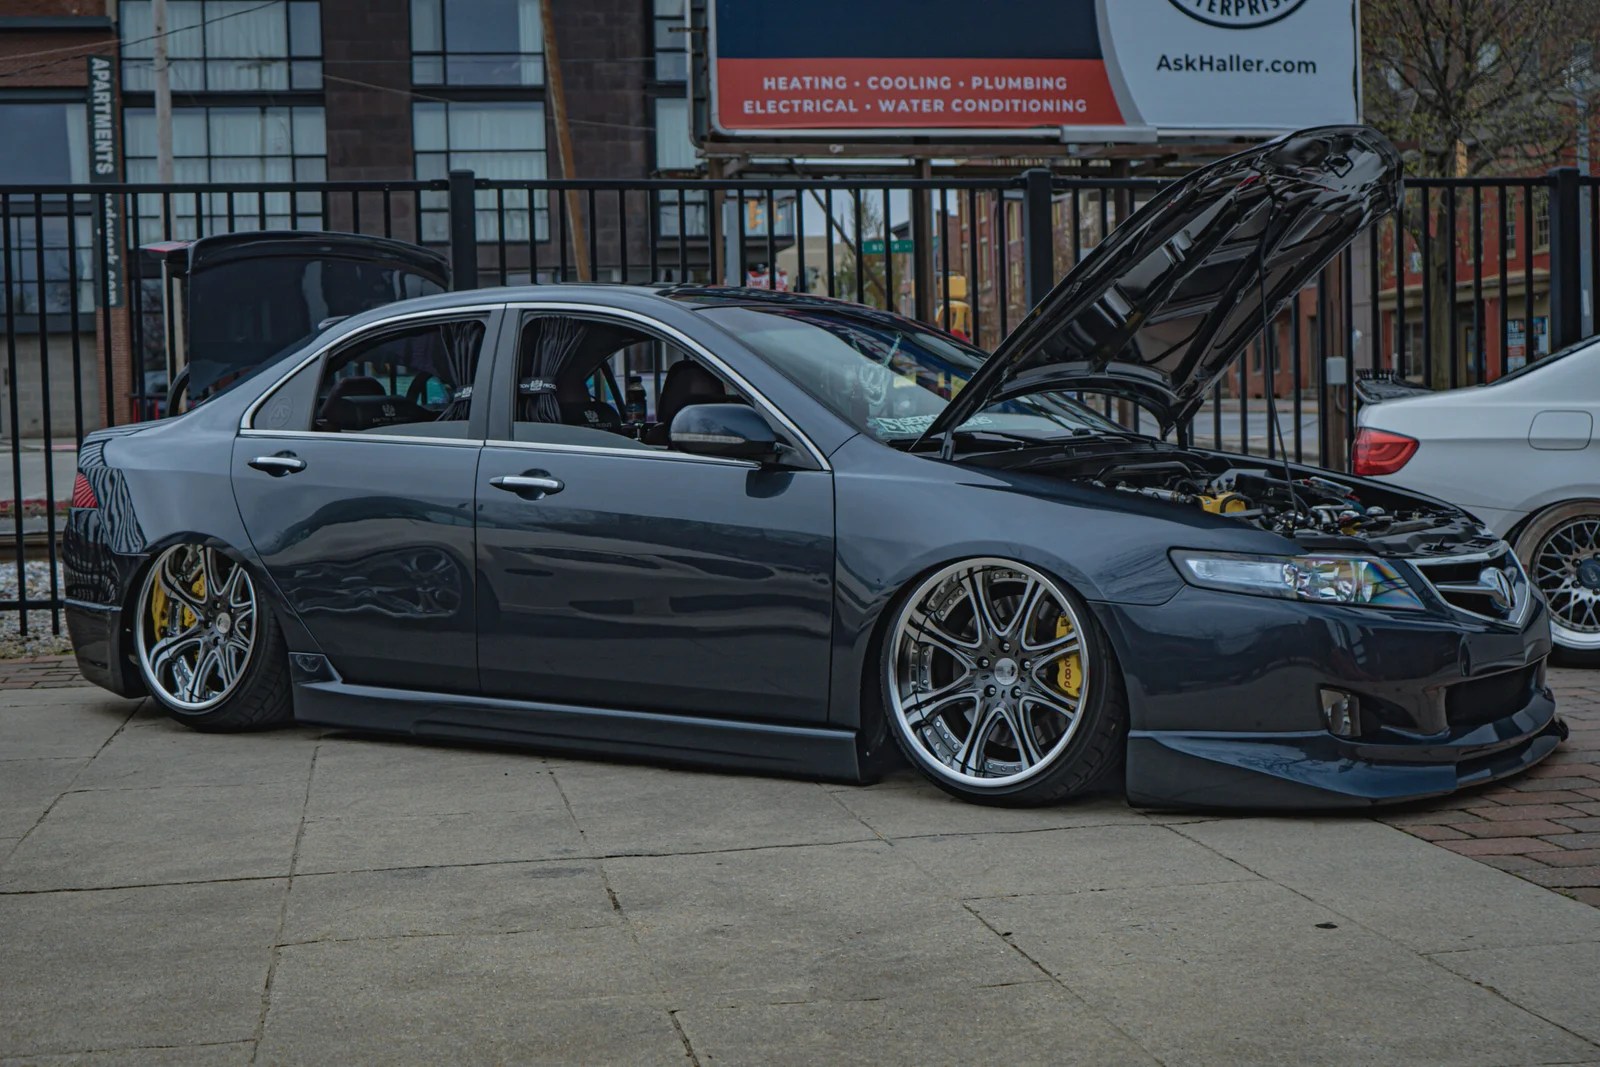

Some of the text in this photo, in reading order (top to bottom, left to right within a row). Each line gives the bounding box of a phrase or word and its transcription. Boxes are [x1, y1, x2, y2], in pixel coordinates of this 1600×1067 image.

[1196, 0, 1288, 16] ERPRIS
[1156, 54, 1317, 74] AskHaller.com
[763, 76, 1067, 90] HEATING COOLING PLUMBING
[743, 99, 1087, 113] ELECTRICAL WATER CONDITIONING
[91, 58, 113, 174] APARTMENTS
